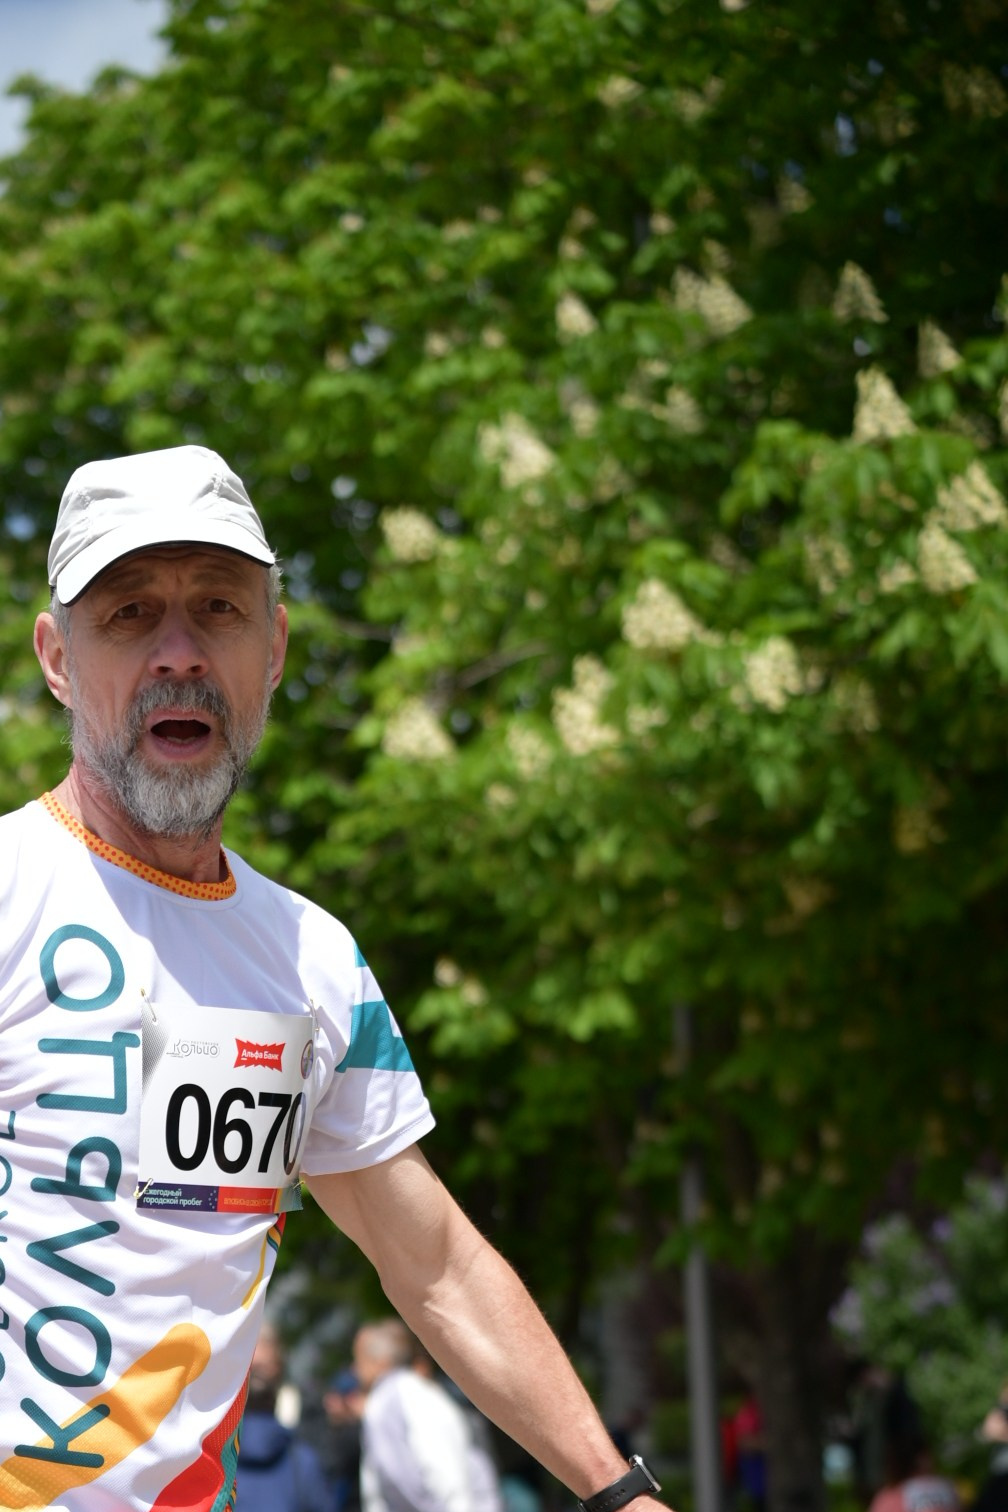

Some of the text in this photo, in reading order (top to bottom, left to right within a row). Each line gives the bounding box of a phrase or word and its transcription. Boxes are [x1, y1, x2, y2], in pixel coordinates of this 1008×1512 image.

[165, 1083, 306, 1176] 0670
[14, 923, 141, 1469] КОЛЬЦО
[143, 1196, 202, 1207] городской пробег
